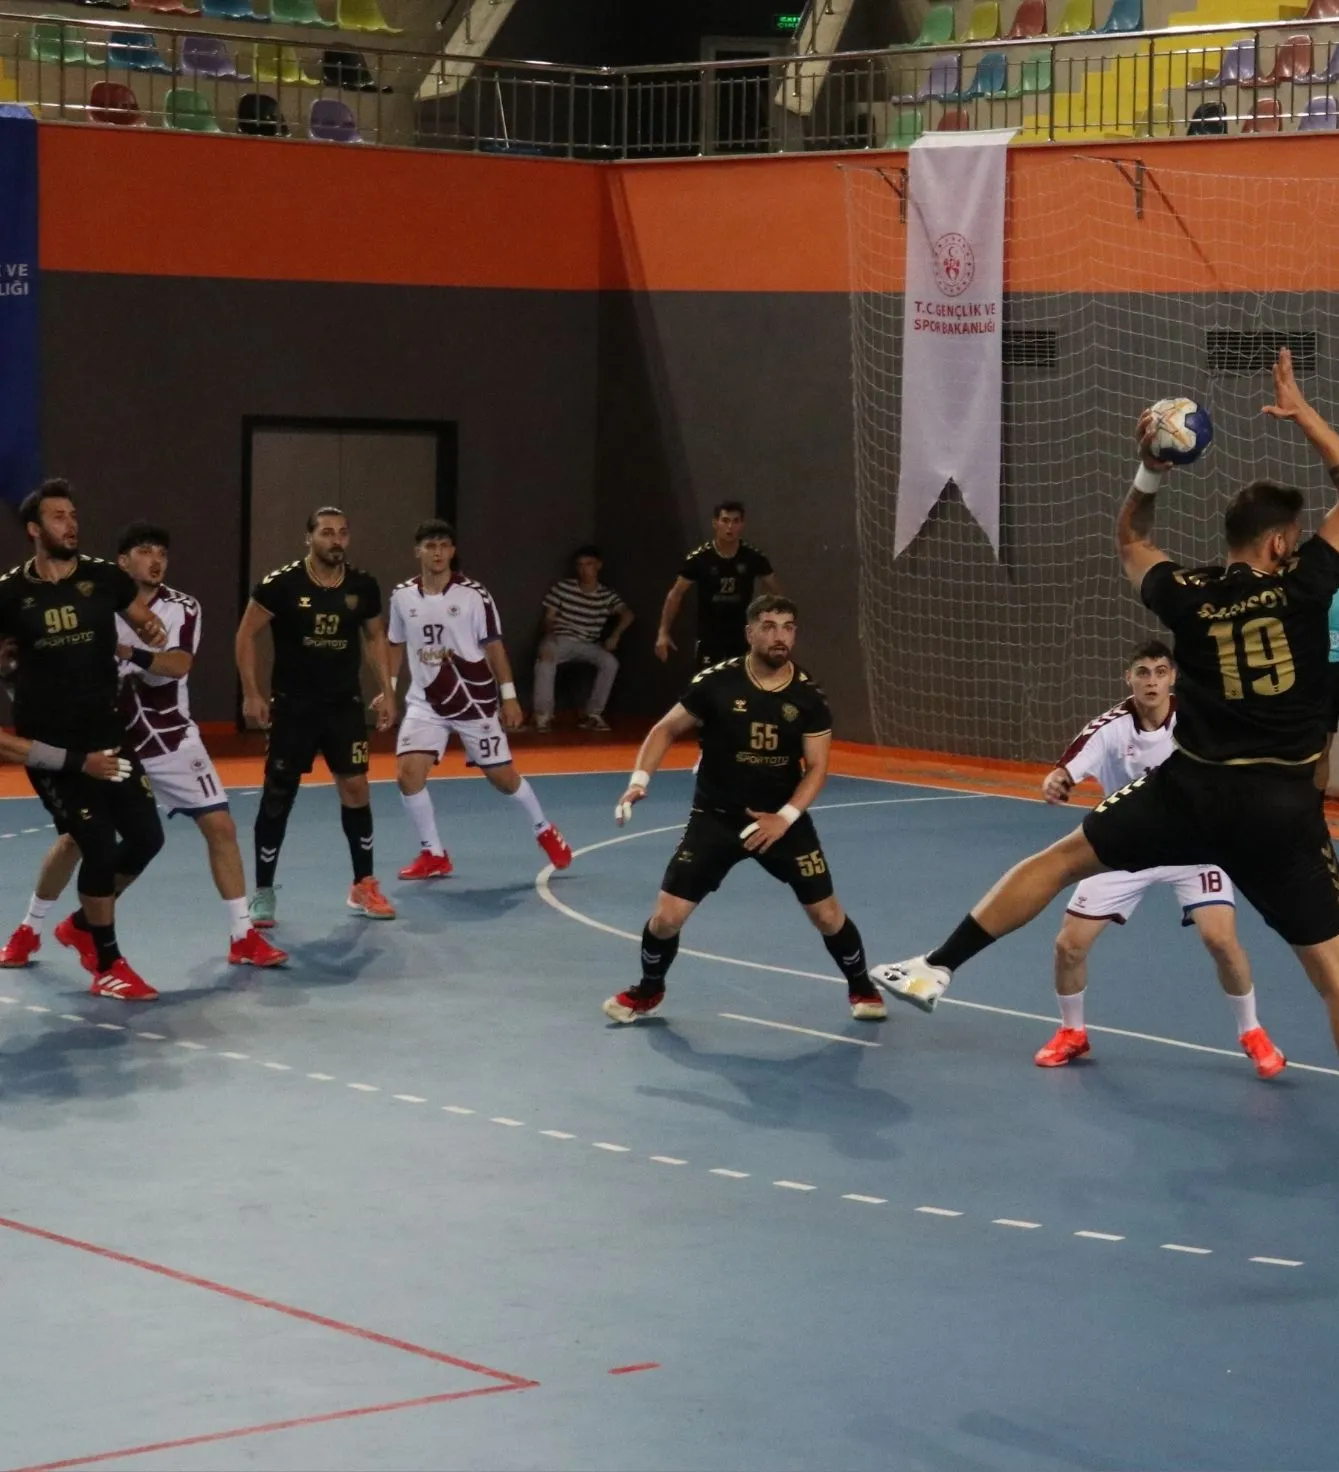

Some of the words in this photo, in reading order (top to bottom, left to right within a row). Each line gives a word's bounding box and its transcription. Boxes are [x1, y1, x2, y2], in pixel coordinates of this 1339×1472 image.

[6, 263, 29, 277] VE
[984, 303, 996, 315] VE
[44, 604, 79, 634] 96
[314, 613, 341, 635] 53
[422, 623, 445, 645] 97
[1207, 617, 1296, 700] 19
[479, 736, 501, 759] 97
[750, 721, 779, 751] 55
[196, 773, 218, 799] 11
[795, 850, 826, 877] 55
[1198, 870, 1223, 893] 18
